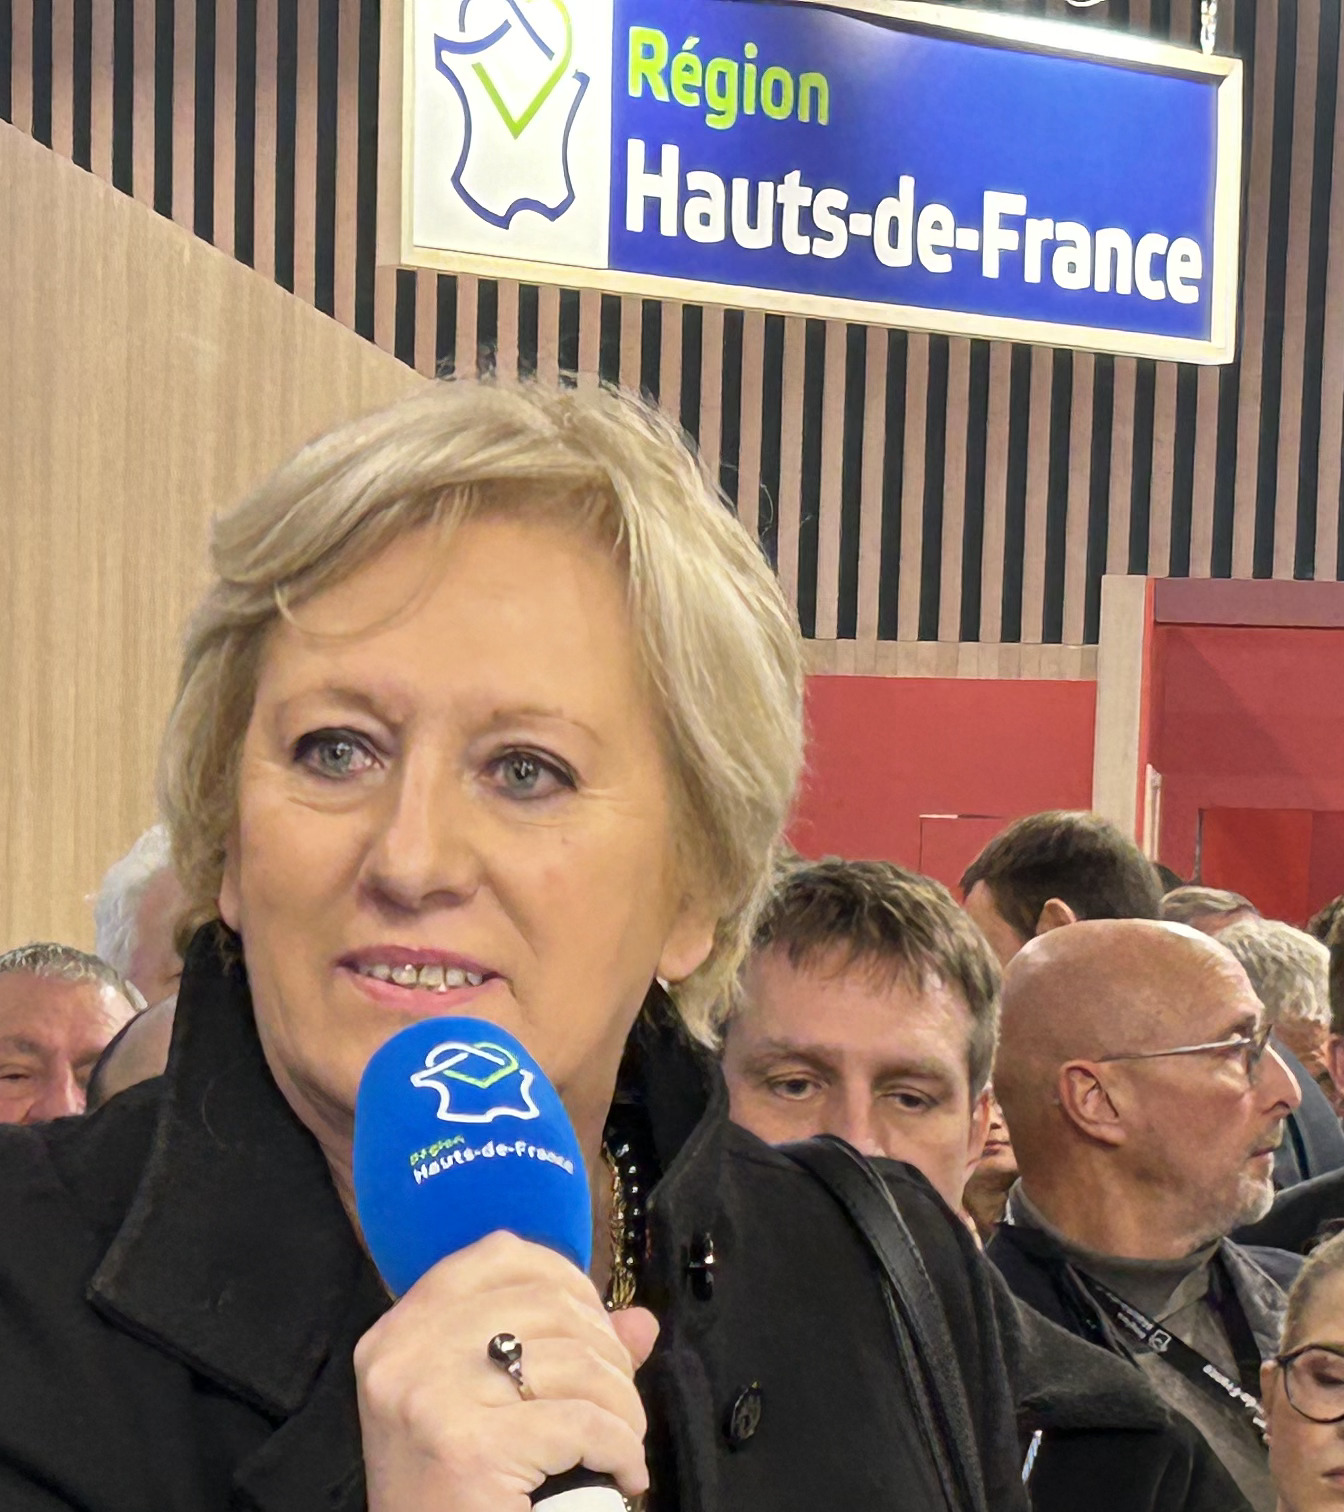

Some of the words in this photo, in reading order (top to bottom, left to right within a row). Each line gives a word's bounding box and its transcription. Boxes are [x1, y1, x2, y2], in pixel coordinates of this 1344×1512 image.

[629, 27, 829, 130] Région
[625, 138, 1203, 305] Hauts-de-France
[413, 1139, 574, 1185] Hauts-de-France
